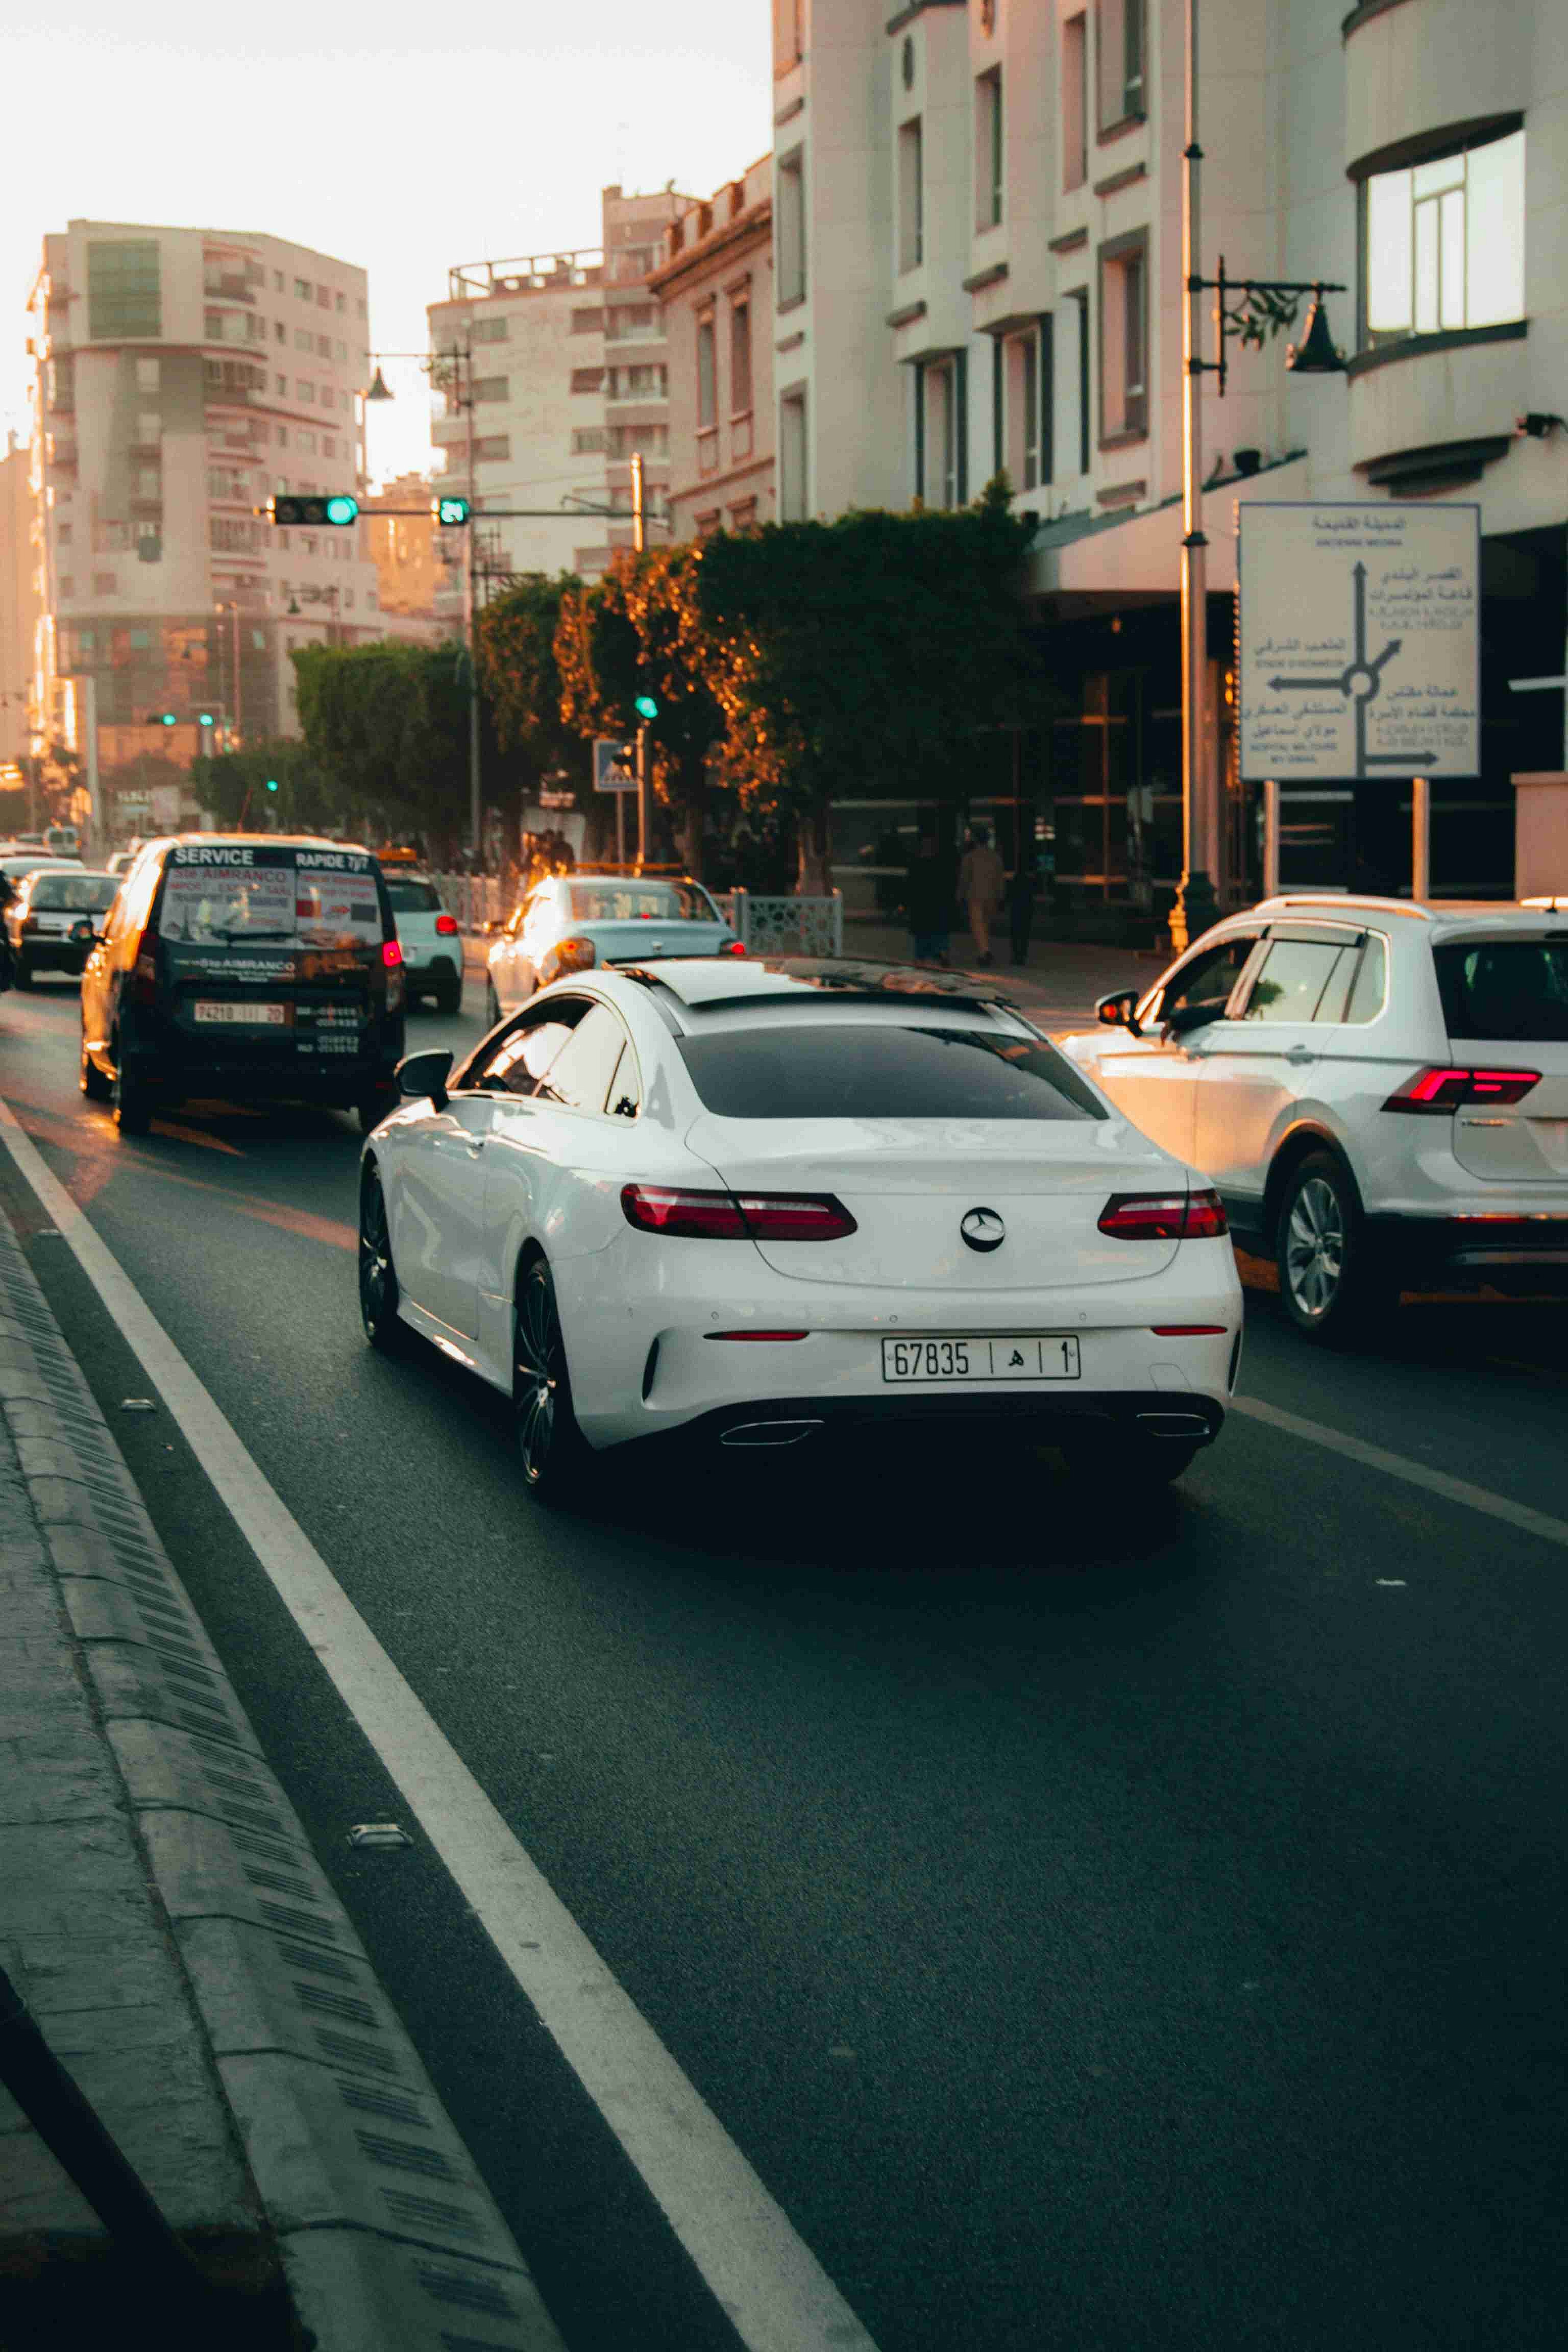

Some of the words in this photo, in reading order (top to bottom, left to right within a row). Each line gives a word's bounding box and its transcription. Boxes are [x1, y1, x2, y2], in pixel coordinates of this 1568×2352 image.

[175, 848, 254, 865] SERVICE
[296, 853, 344, 869] RAPIDE
[894, 1342, 969, 1376] 67835
[1061, 1341, 1069, 1373] 1
